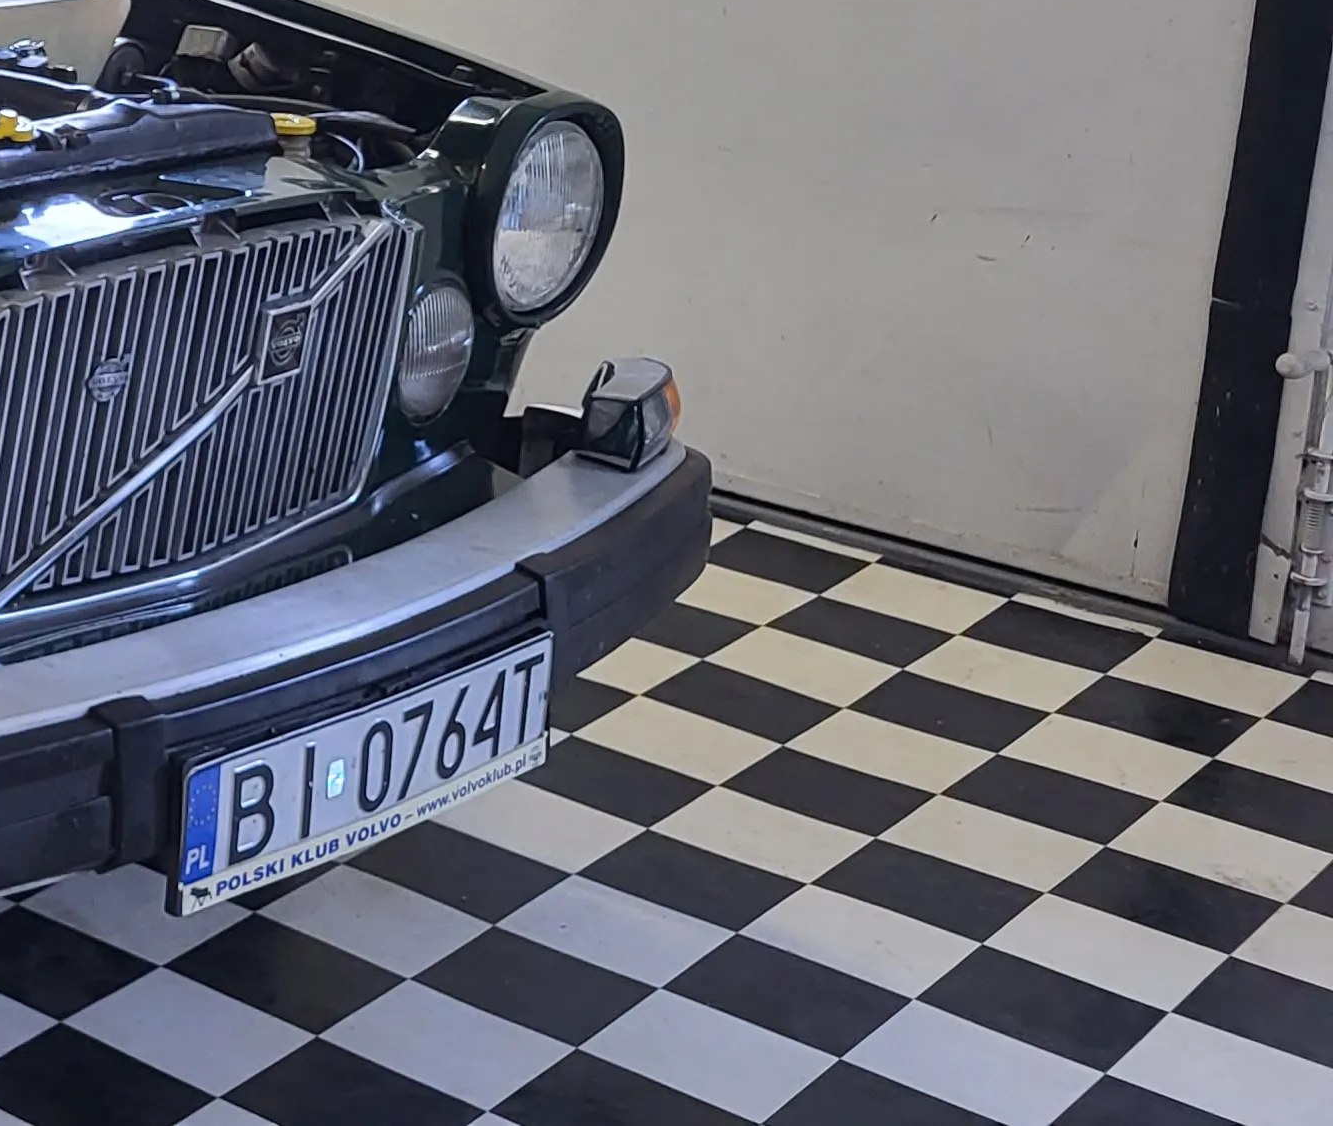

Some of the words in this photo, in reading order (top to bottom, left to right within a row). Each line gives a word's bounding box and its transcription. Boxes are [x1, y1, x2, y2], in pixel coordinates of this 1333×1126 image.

[215, 857, 285, 897] POLSKI
[290, 837, 340, 869] KLUB
[345, 812, 402, 848] VOLVO
[416, 753, 527, 818] www.volvoklub.pl
[228, 741, 317, 867] BI
[357, 651, 546, 813] 0764T
[185, 844, 211, 876] PL
